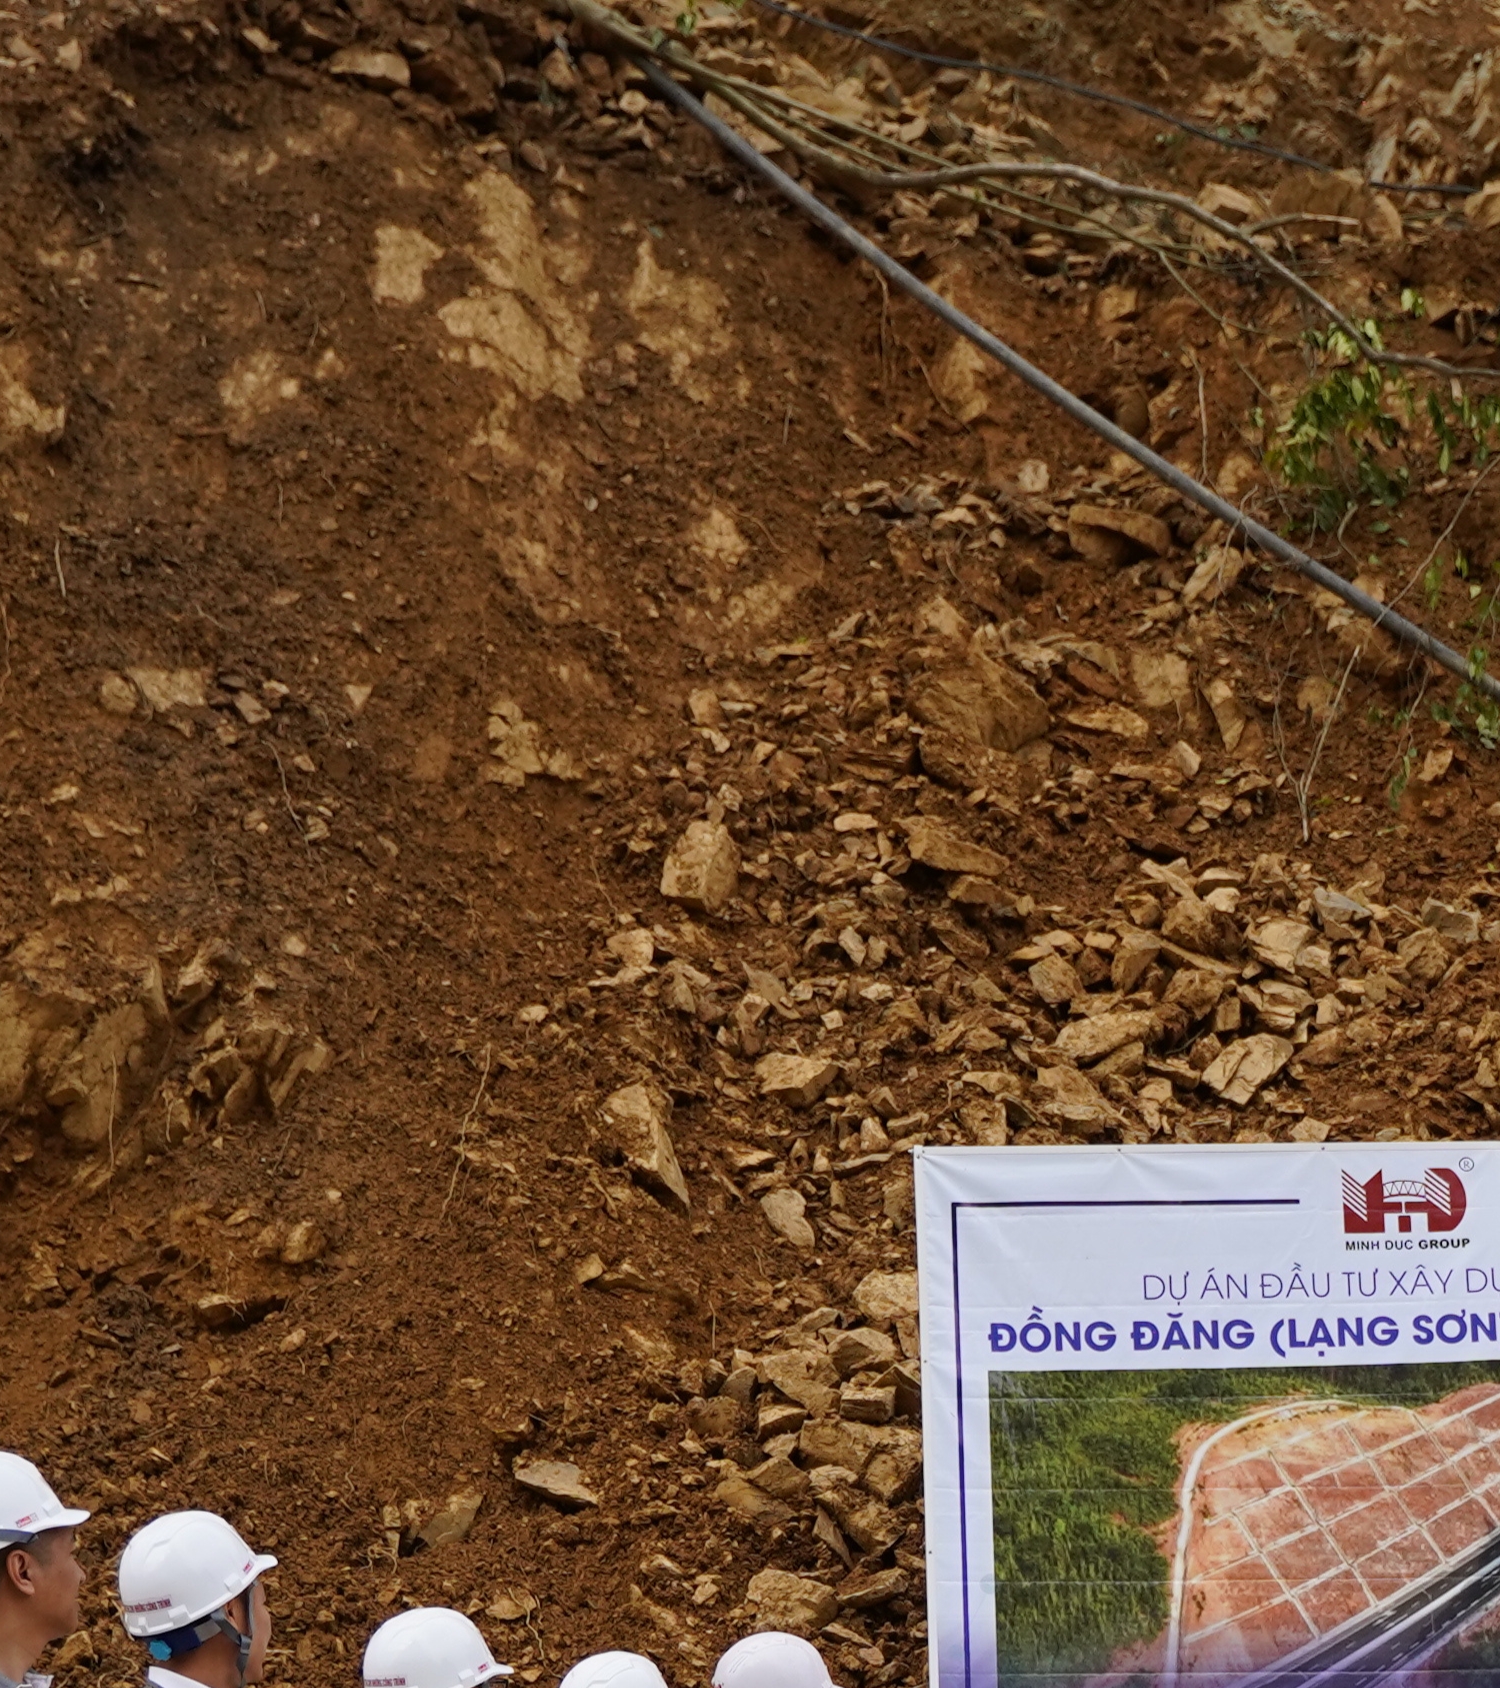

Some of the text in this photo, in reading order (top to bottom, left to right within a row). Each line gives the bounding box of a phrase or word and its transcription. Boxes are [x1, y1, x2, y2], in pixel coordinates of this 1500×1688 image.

[1345, 1238, 1470, 1251] MINH DUC GROUP
[1143, 1270, 1190, 1306] DỰ
[1200, 1268, 1249, 1300] ÁN
[1259, 1262, 1331, 1299] ĐẦU
[1341, 1268, 1380, 1298] TƯ
[1389, 1263, 1453, 1296] XÂY
[988, 1305, 1116, 1353] ĐỒNG
[1130, 1312, 1254, 1351] ĐĂNG
[1270, 1316, 1399, 1358] (LẠNG
